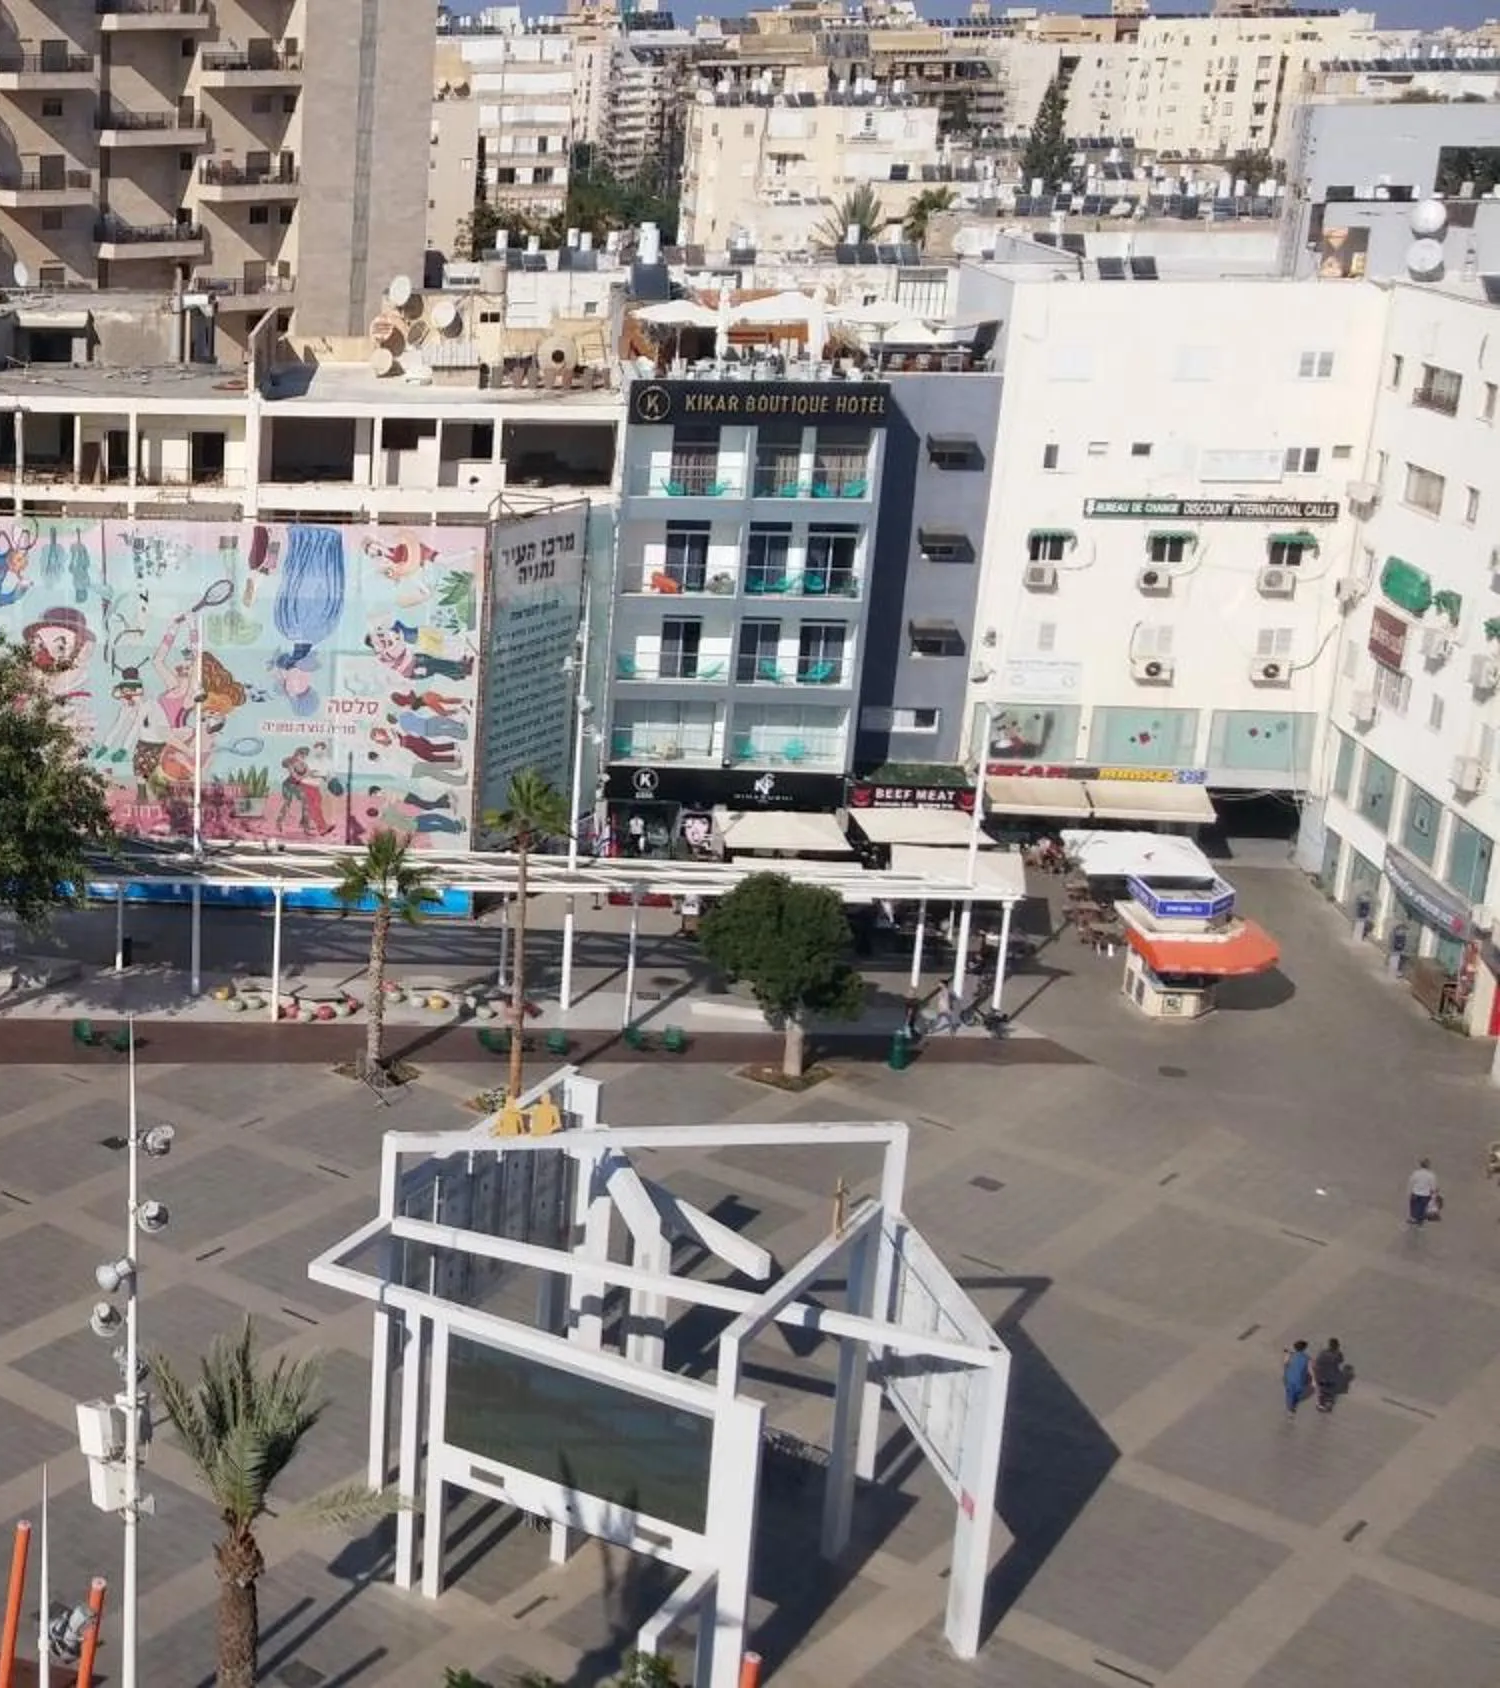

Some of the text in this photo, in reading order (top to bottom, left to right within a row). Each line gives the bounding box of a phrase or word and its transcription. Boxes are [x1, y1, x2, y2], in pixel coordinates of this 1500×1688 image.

[685, 394, 885, 415] KIKAR BOUTIQUE HOTEL
[1095, 501, 1129, 513] BUREAU
[1131, 502, 1143, 513] DE
[1183, 503, 1230, 516] DISCOUNT
[1231, 503, 1302, 517] INTERNATIONAL
[1303, 504, 1337, 518] CALLS
[501, 532, 574, 567] מרכז העיר
[518, 560, 555, 585] נתניה
[327, 698, 379, 715] סלסה
[874, 787, 957, 801] BEEF MEAT
